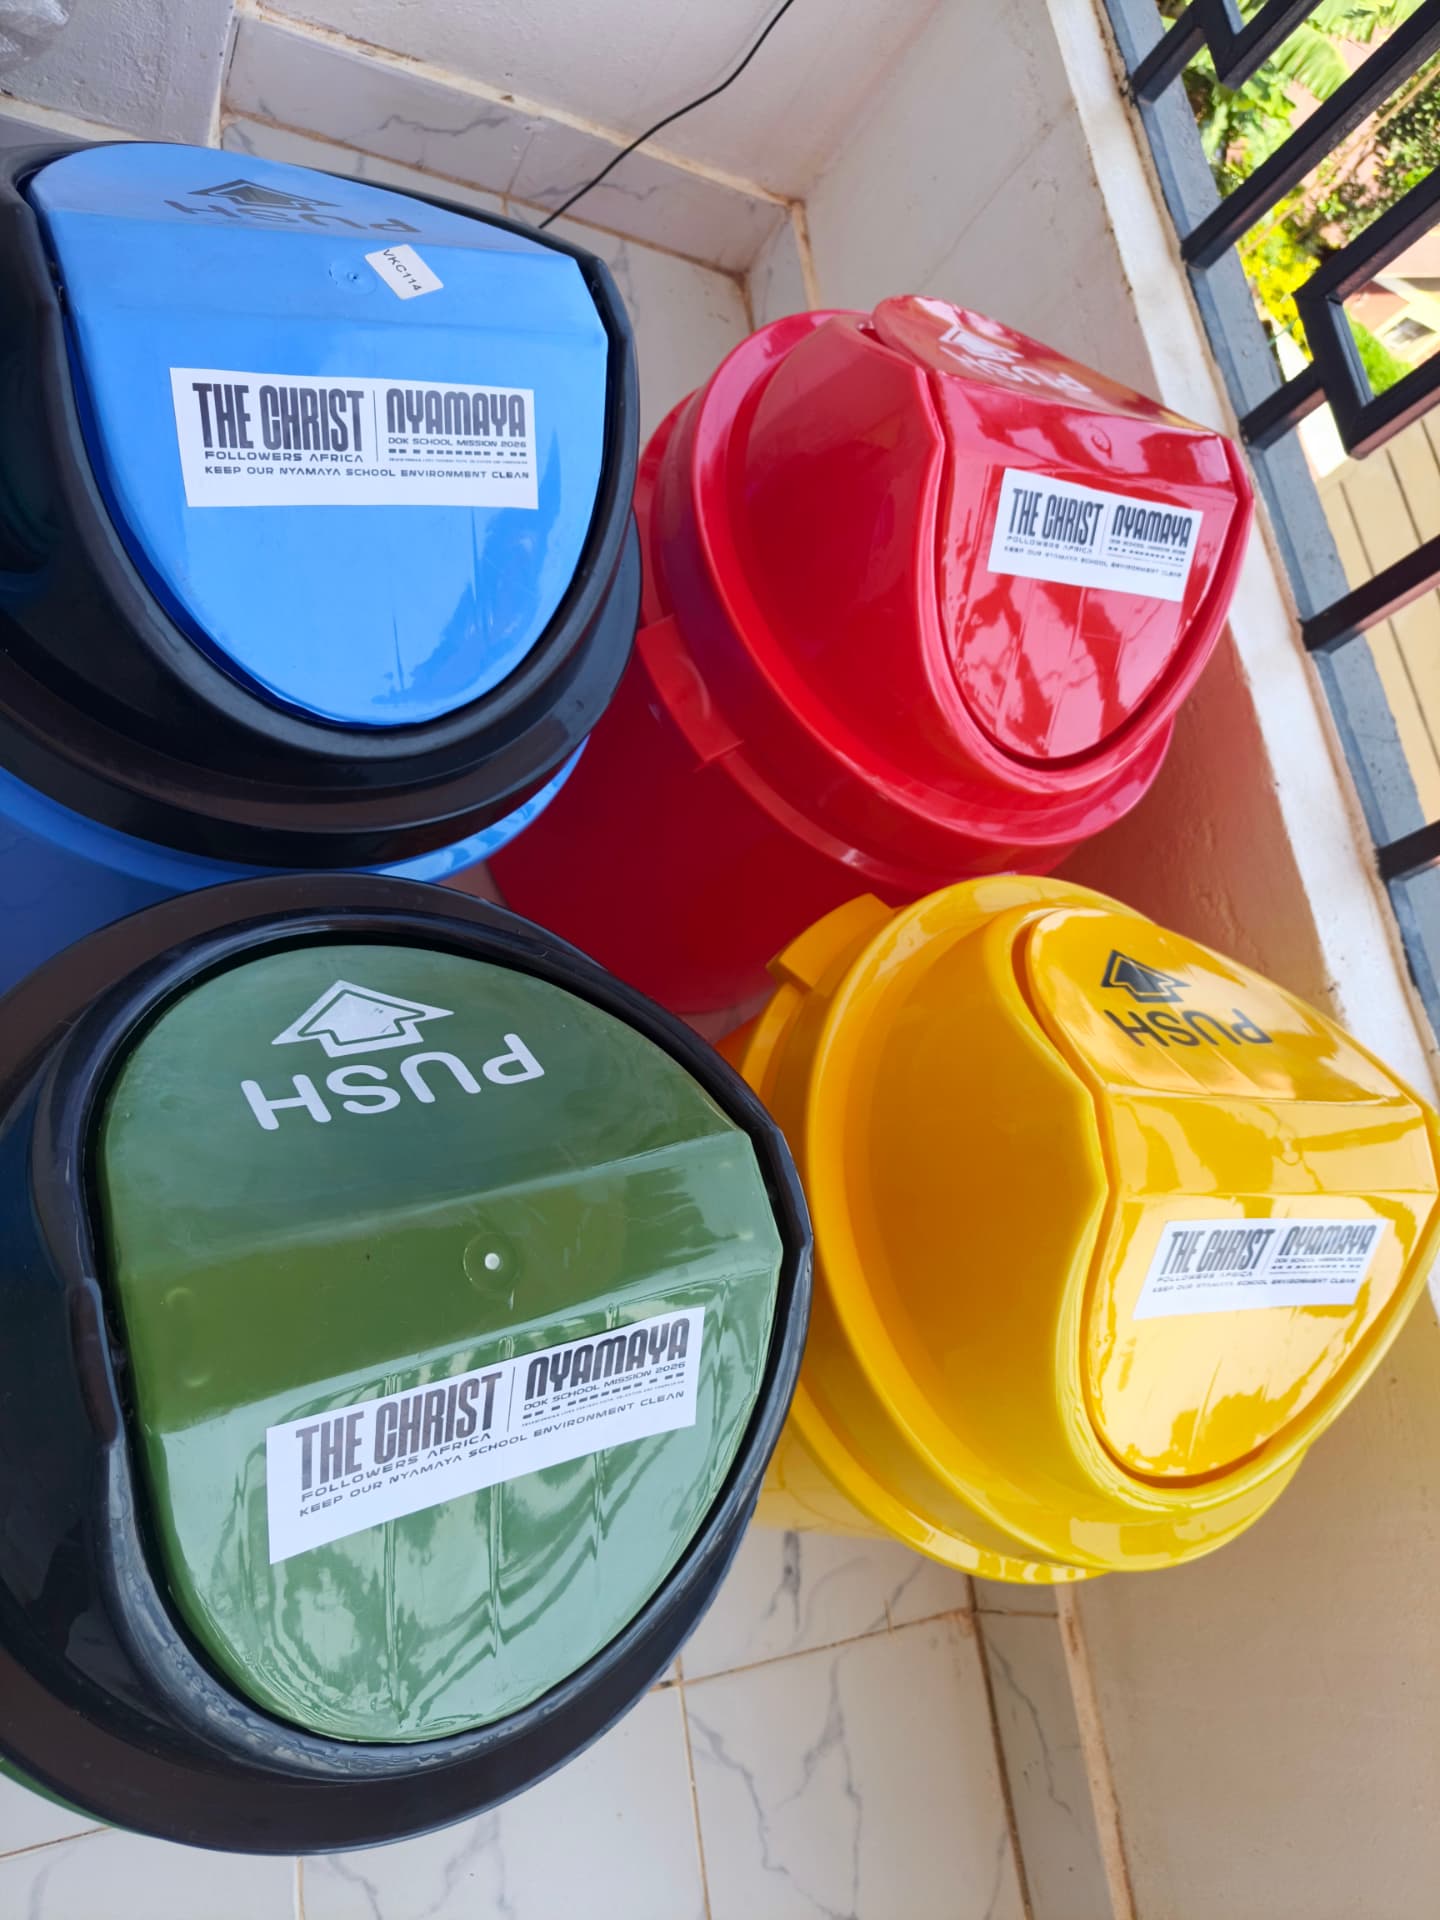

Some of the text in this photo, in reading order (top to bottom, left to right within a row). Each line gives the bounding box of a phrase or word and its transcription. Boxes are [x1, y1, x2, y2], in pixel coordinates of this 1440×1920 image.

[163, 199, 423, 233] PUSH
[383, 249, 422, 291] VKC114
[192, 382, 364, 452] THE CHRIST
[386, 388, 527, 438] NYAMAYA
[205, 451, 363, 463] FOLLOWERS AFRICA
[388, 437, 409, 445] DOK
[412, 438, 453, 446] SCHOOL
[456, 439, 498, 447] MISSION
[205, 466, 529, 479] KEEP OUR NYAMAYA SCHOOL ENVIRONMENT CLEAN
[1009, 488, 1104, 546] THE CHRIST
[1111, 505, 1193, 548] NYAMAYA
[1103, 1008, 1273, 1047] PUSH
[241, 1033, 545, 1130] PUSH
[1161, 1228, 1275, 1275] THE CHRIST
[1278, 1225, 1377, 1256] NYAMAYA
[524, 1318, 690, 1401] NYAMAYA
[523, 1399, 549, 1411] DOK
[552, 1385, 601, 1402] SCHOOL
[604, 1370, 651, 1388] MISSION
[296, 1411, 365, 1491] THE
[374, 1371, 503, 1466] CHRIST
[299, 1495, 343, 1517] KEEP
[350, 1481, 383, 1498] OUR
[389, 1455, 462, 1484] NYAMAYA
[468, 1435, 528, 1457] SCHOOL
[533, 1402, 635, 1437] ENVIRONMENT
[640, 1390, 685, 1406] CLEAN
[301, 1432, 491, 1502] FOLLOWERS AFRICA
